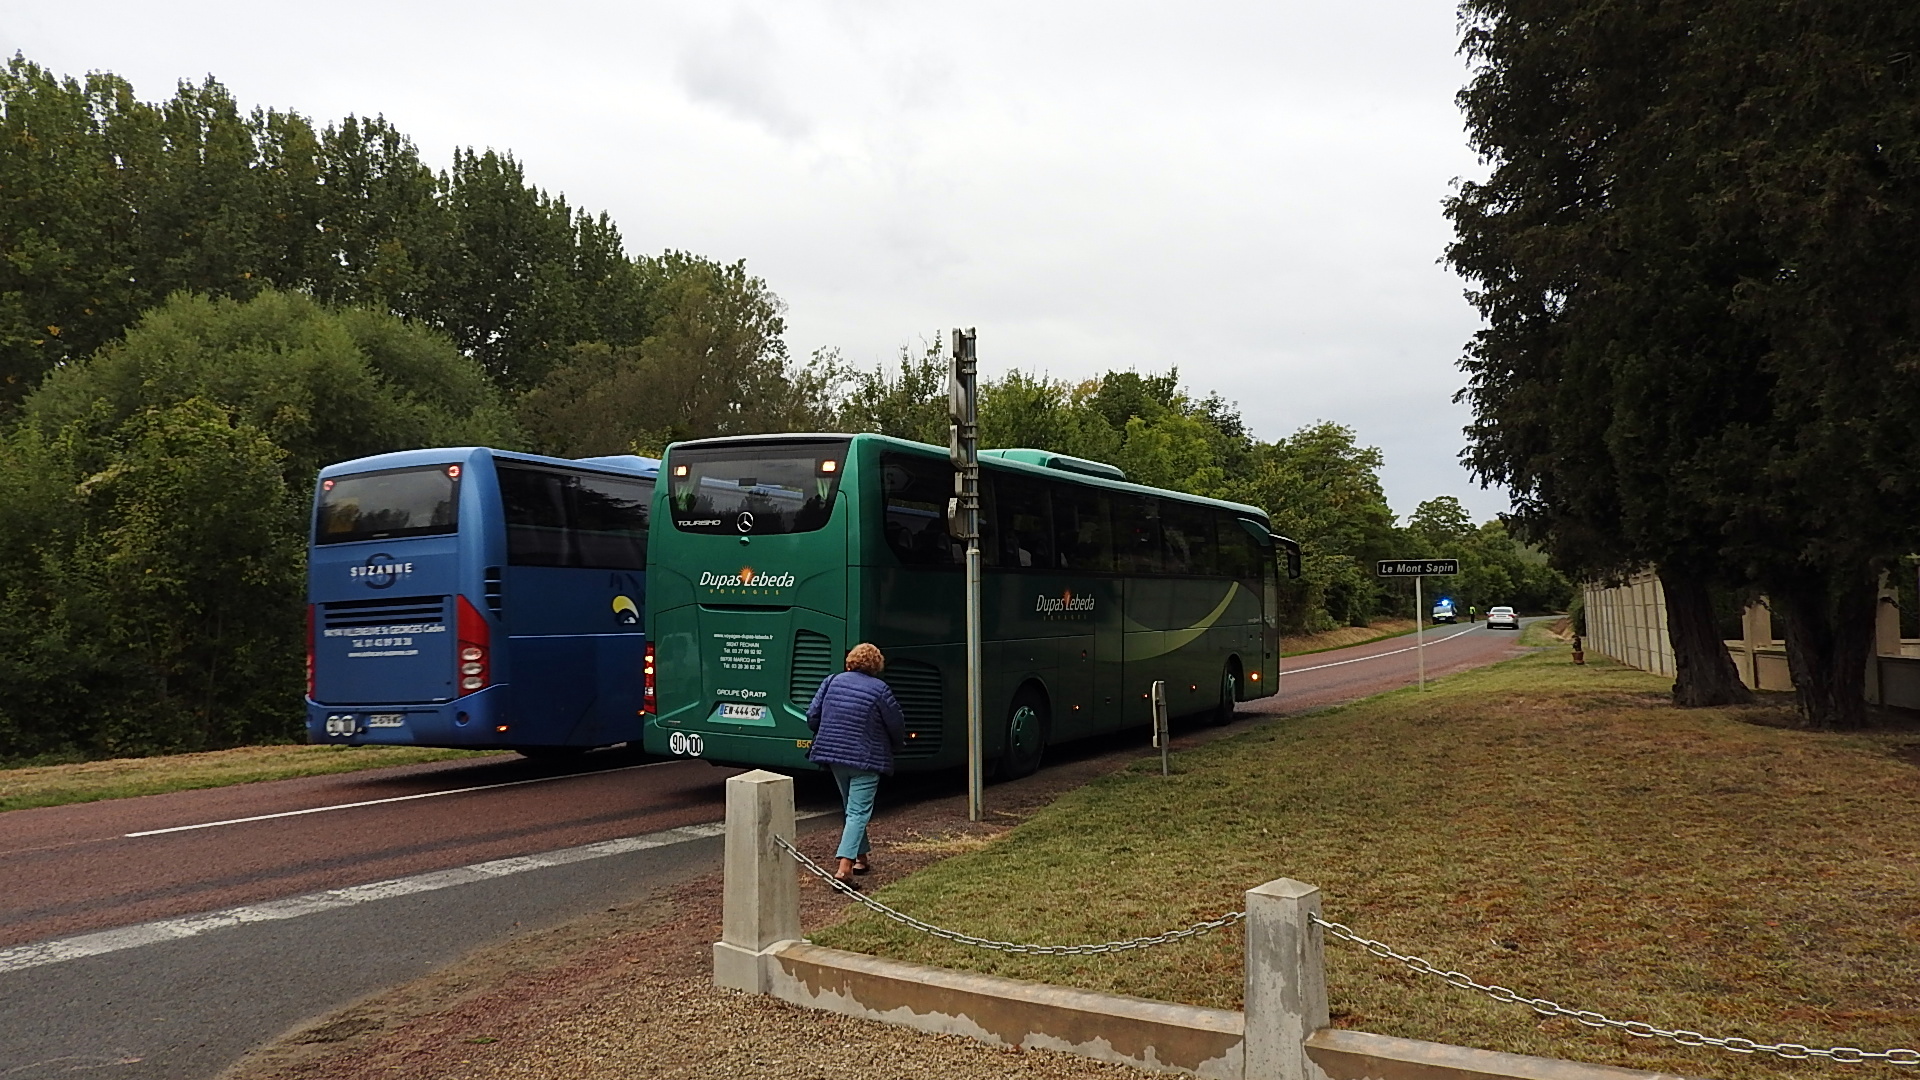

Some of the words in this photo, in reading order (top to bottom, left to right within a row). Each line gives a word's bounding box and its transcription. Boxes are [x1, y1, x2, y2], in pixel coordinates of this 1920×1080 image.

[350, 562, 413, 576] SUZANNE
[1381, 564, 1393, 574] Le
[1396, 563, 1422, 573] Mont
[1425, 563, 1454, 574] Sapin
[699, 571, 742, 589] Dupas
[743, 571, 795, 587] Lebeda
[1035, 594, 1064, 615] Dupas
[1065, 593, 1095, 611] Lebeda
[716, 688, 741, 697] GROUPE
[672, 734, 684, 752] 90
[688, 736, 702, 754] 100
